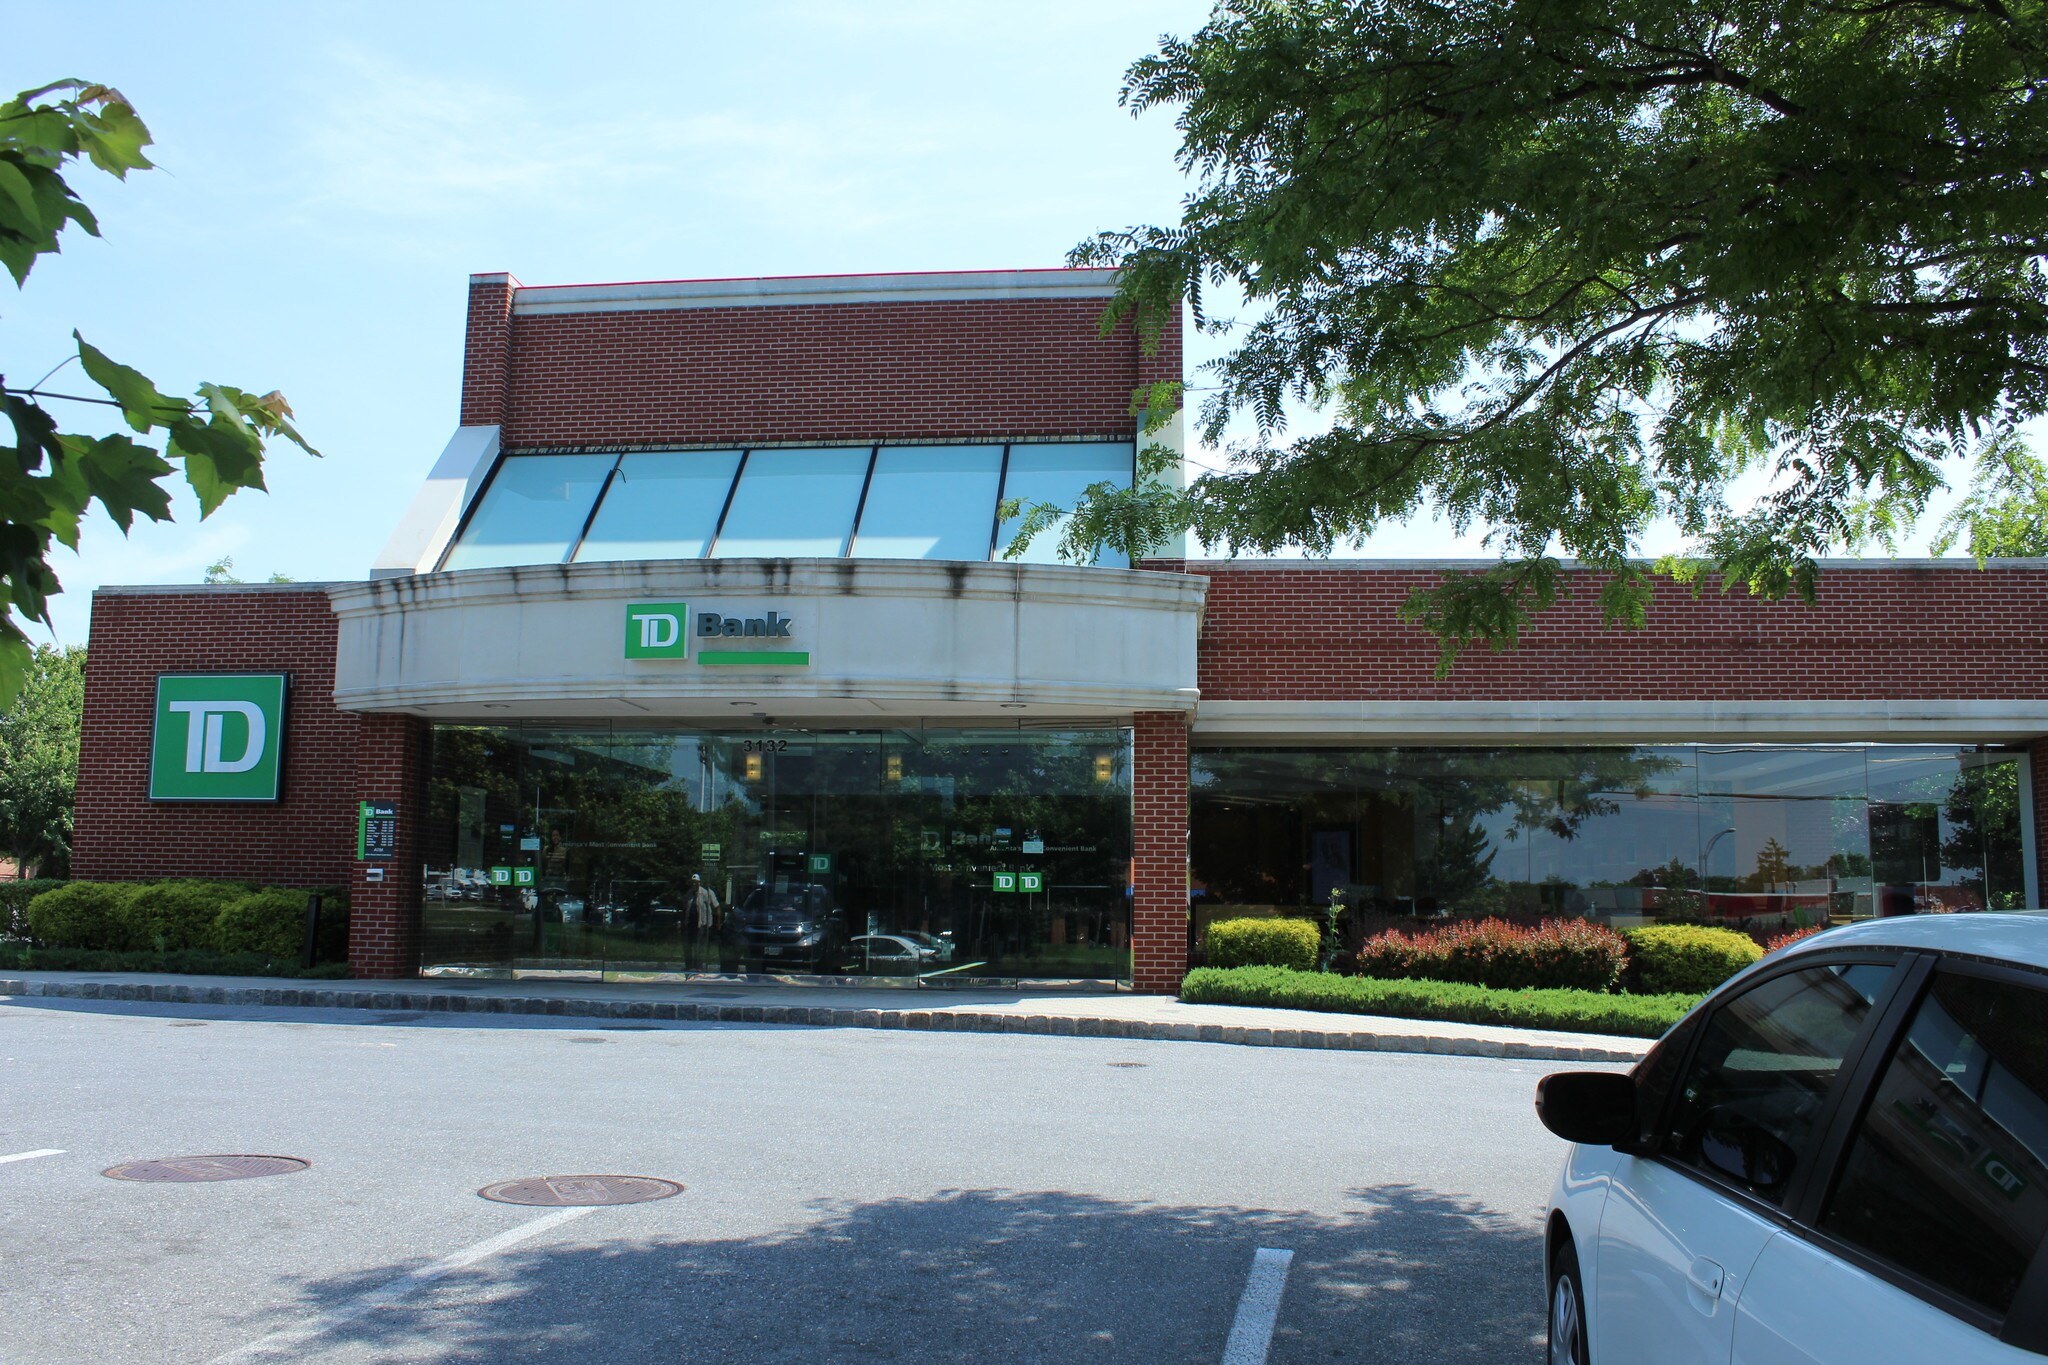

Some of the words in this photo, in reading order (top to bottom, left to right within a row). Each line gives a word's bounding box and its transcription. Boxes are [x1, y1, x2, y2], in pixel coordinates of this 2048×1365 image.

[632, 613, 679, 648] TD
[697, 611, 792, 638] Bank
[169, 700, 266, 773] TD
[743, 739, 788, 752] 3132
[364, 808, 374, 816] TD
[810, 856, 829, 870] TD
[492, 869, 510, 883] TD
[515, 870, 533, 883] TD
[995, 875, 1014, 889] TD
[1021, 875, 1039, 889] TD
